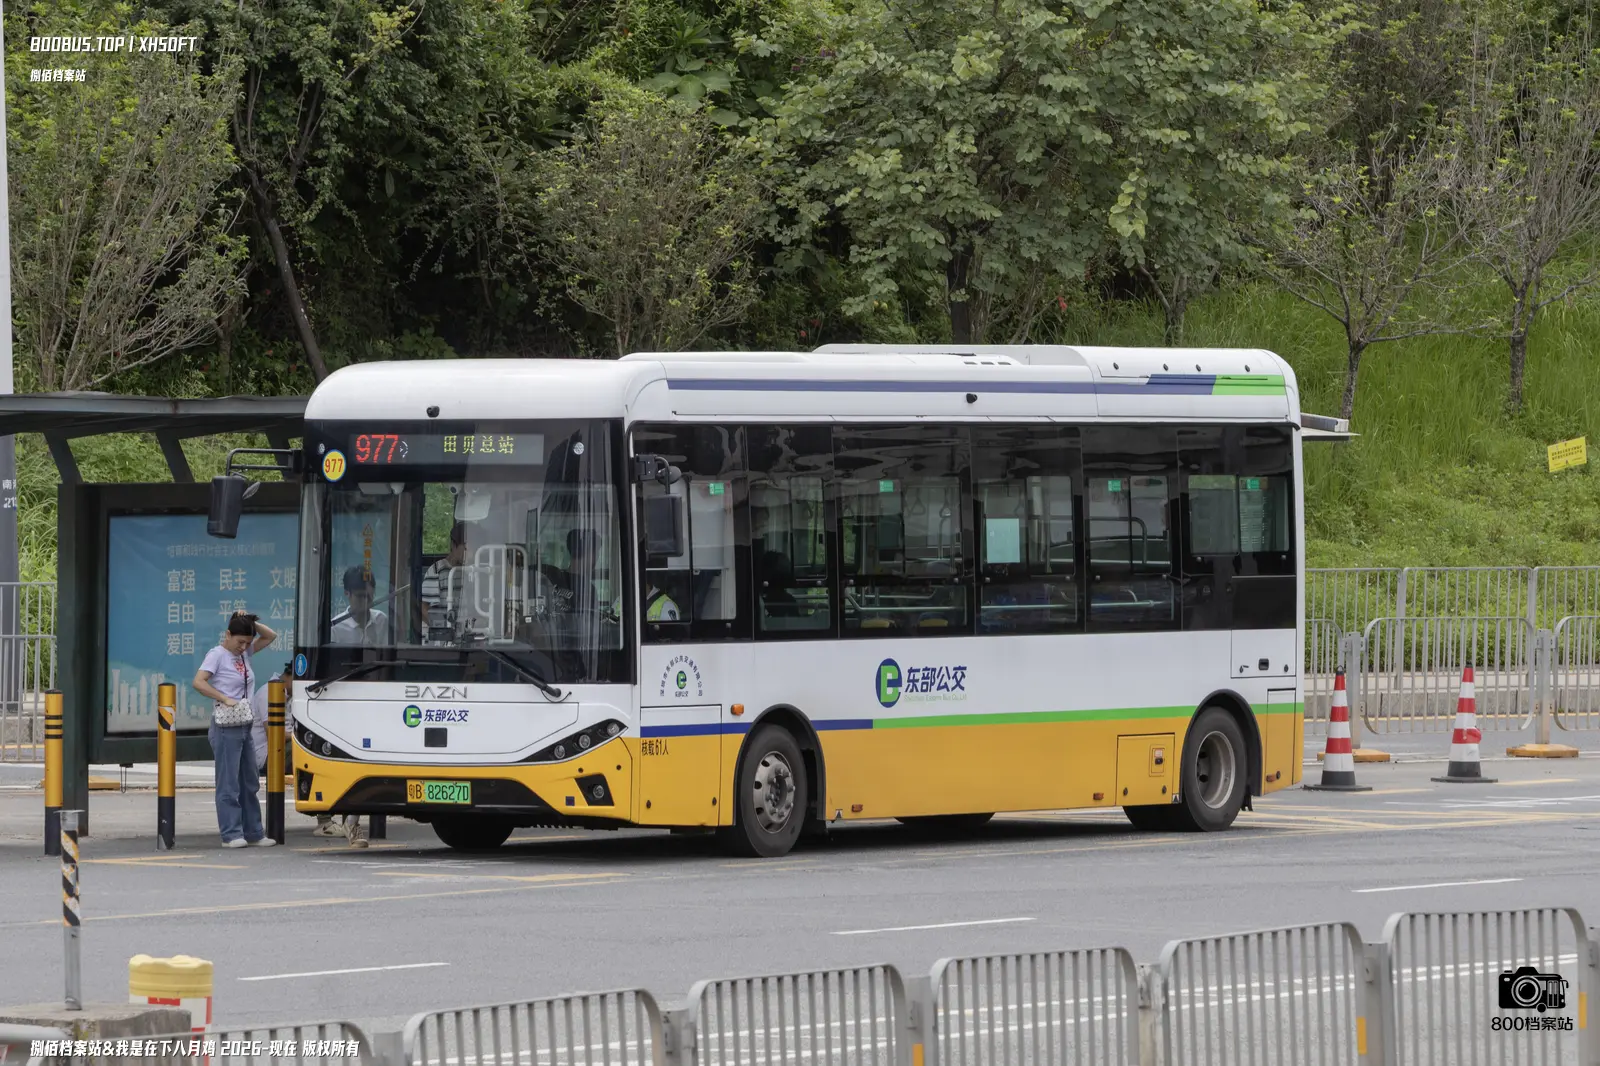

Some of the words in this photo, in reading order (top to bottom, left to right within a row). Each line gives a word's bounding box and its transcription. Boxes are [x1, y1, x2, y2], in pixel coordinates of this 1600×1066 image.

[355, 434, 399, 463] 977
[443, 435, 514, 454] 田贝总站
[325, 458, 344, 473] 977
[167, 569, 196, 592] 富强
[219, 567, 247, 591] 民主
[269, 566, 296, 589] 文明
[167, 601, 195, 624] 自由
[269, 598, 295, 620] 公正
[167, 632, 195, 656] 爱国
[905, 665, 967, 693] 东部公交
[423, 709, 470, 723] 东部公交
[641, 739, 669, 756] 核载61人
[428, 785, 469, 801] 82627D
